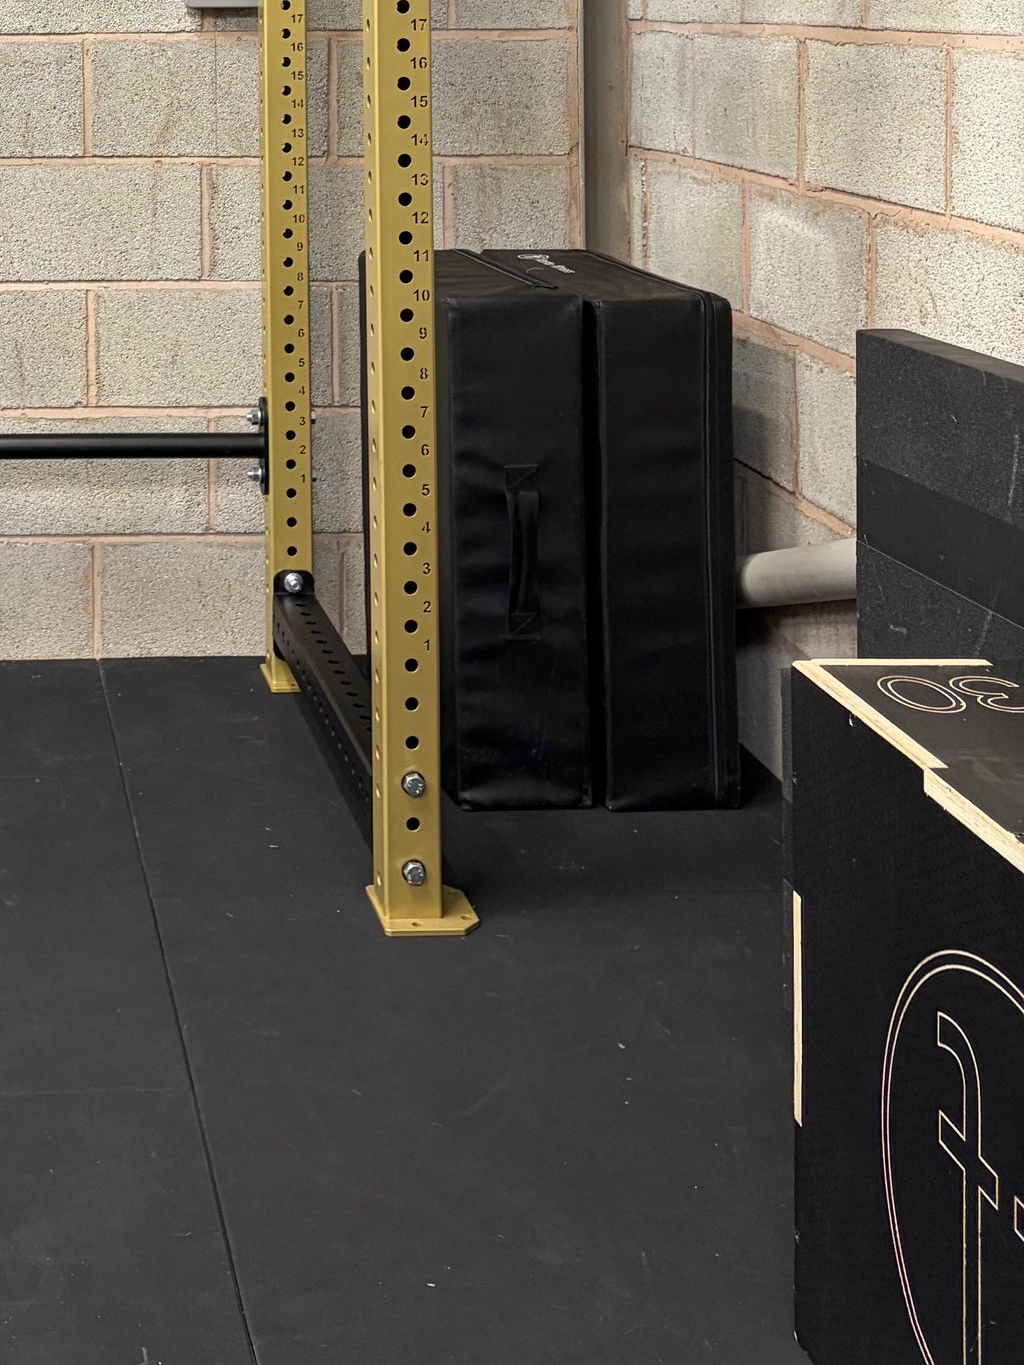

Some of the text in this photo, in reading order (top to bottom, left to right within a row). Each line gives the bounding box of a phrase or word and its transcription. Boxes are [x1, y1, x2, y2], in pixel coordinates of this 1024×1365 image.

[409, 18, 428, 32] 17
[409, 56, 428, 70] 16
[410, 94, 429, 108] 15
[410, 133, 429, 147] 14
[411, 172, 429, 187] 13
[411, 211, 430, 225] 12
[412, 249, 429, 263] 11
[412, 288, 431, 302] 10
[418, 326, 428, 340] 9
[419, 367, 429, 380] 8
[419, 405, 429, 419] 7
[420, 443, 430, 457] 6
[421, 483, 431, 497] 5
[421, 521, 432, 534] 4
[422, 561, 431, 575] 3
[422, 600, 432, 613] 2
[423, 638, 431, 652] 1
